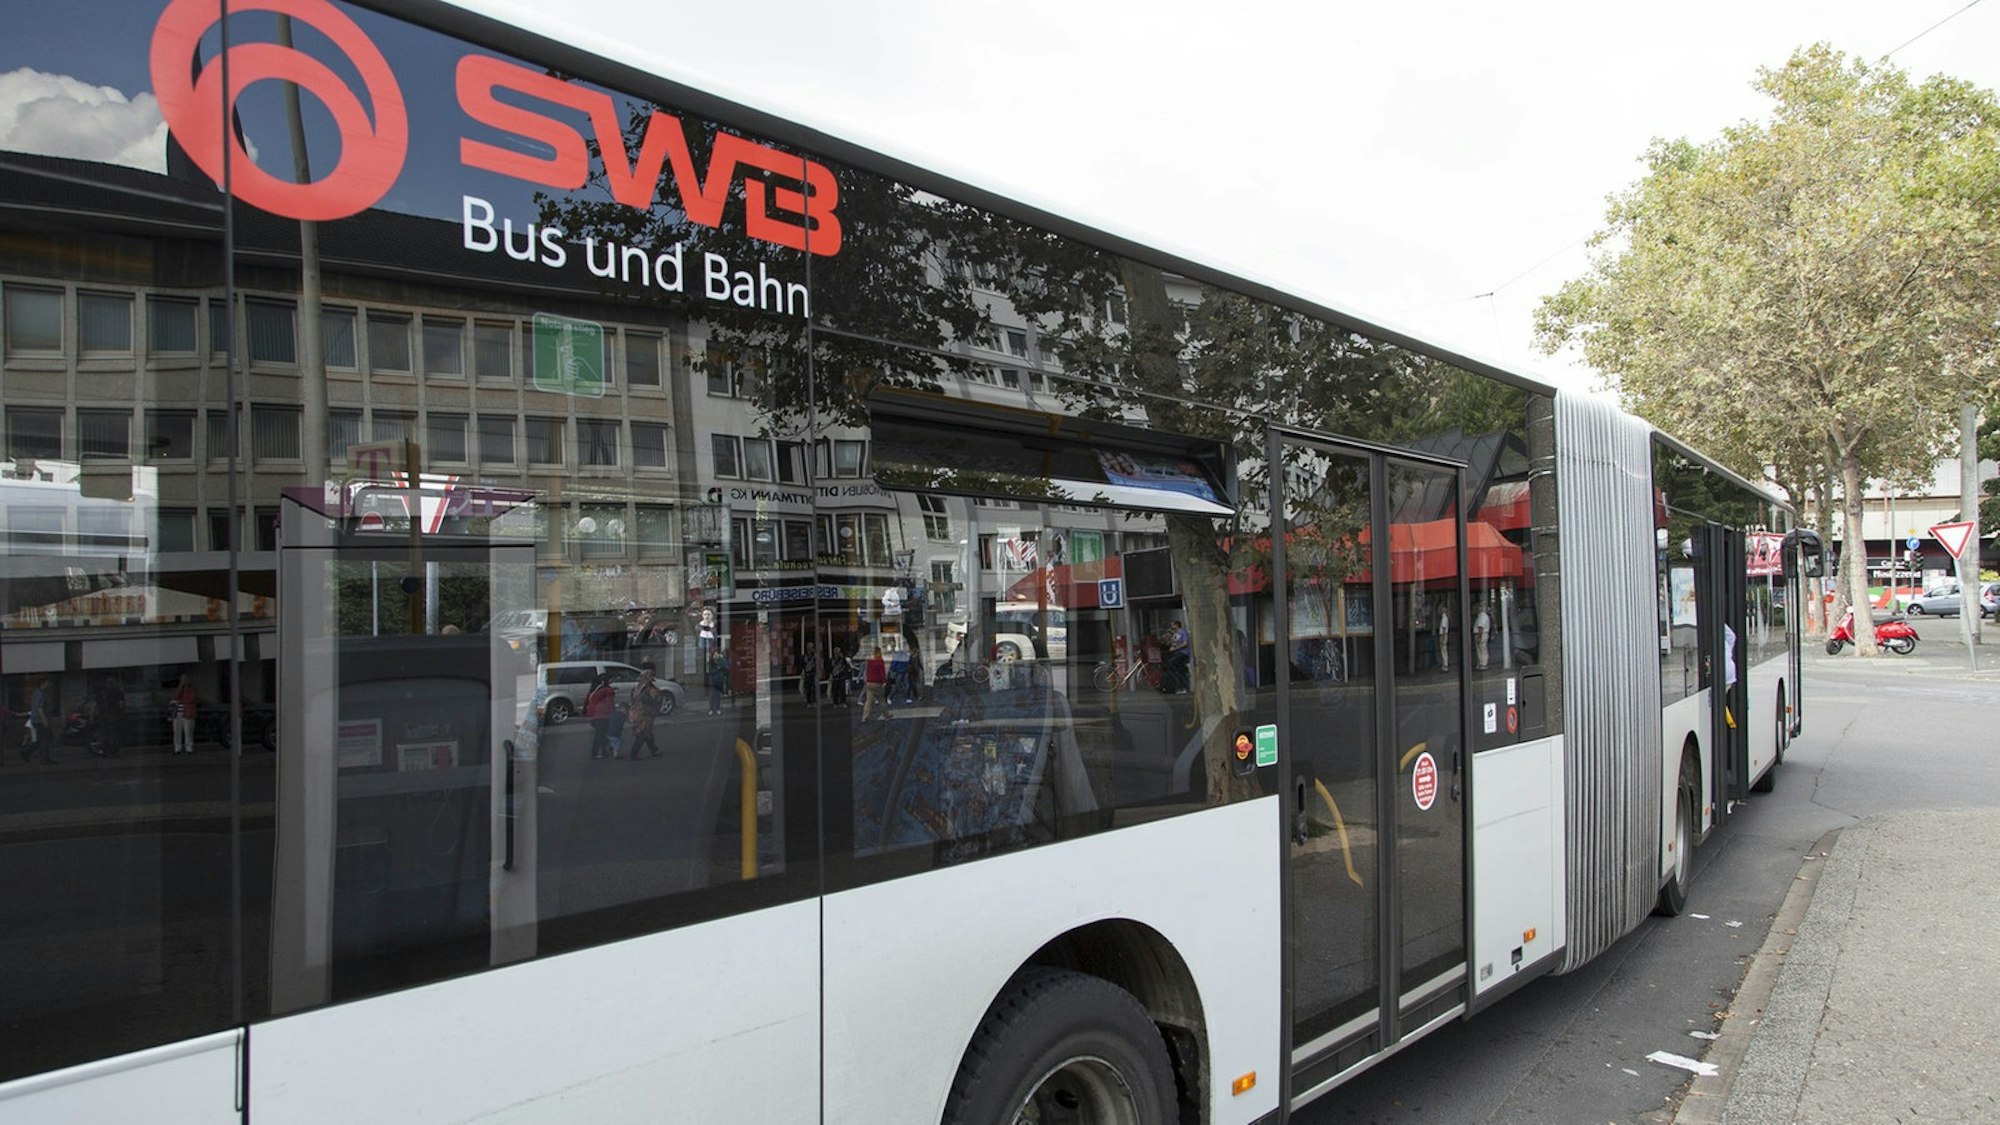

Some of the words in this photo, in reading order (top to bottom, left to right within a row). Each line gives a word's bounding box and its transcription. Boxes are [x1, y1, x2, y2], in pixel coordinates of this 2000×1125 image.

[455, 54, 843, 257] SWB
[462, 194, 568, 269] Bus
[586, 242, 684, 293] und
[704, 251, 809, 319] Bahn
